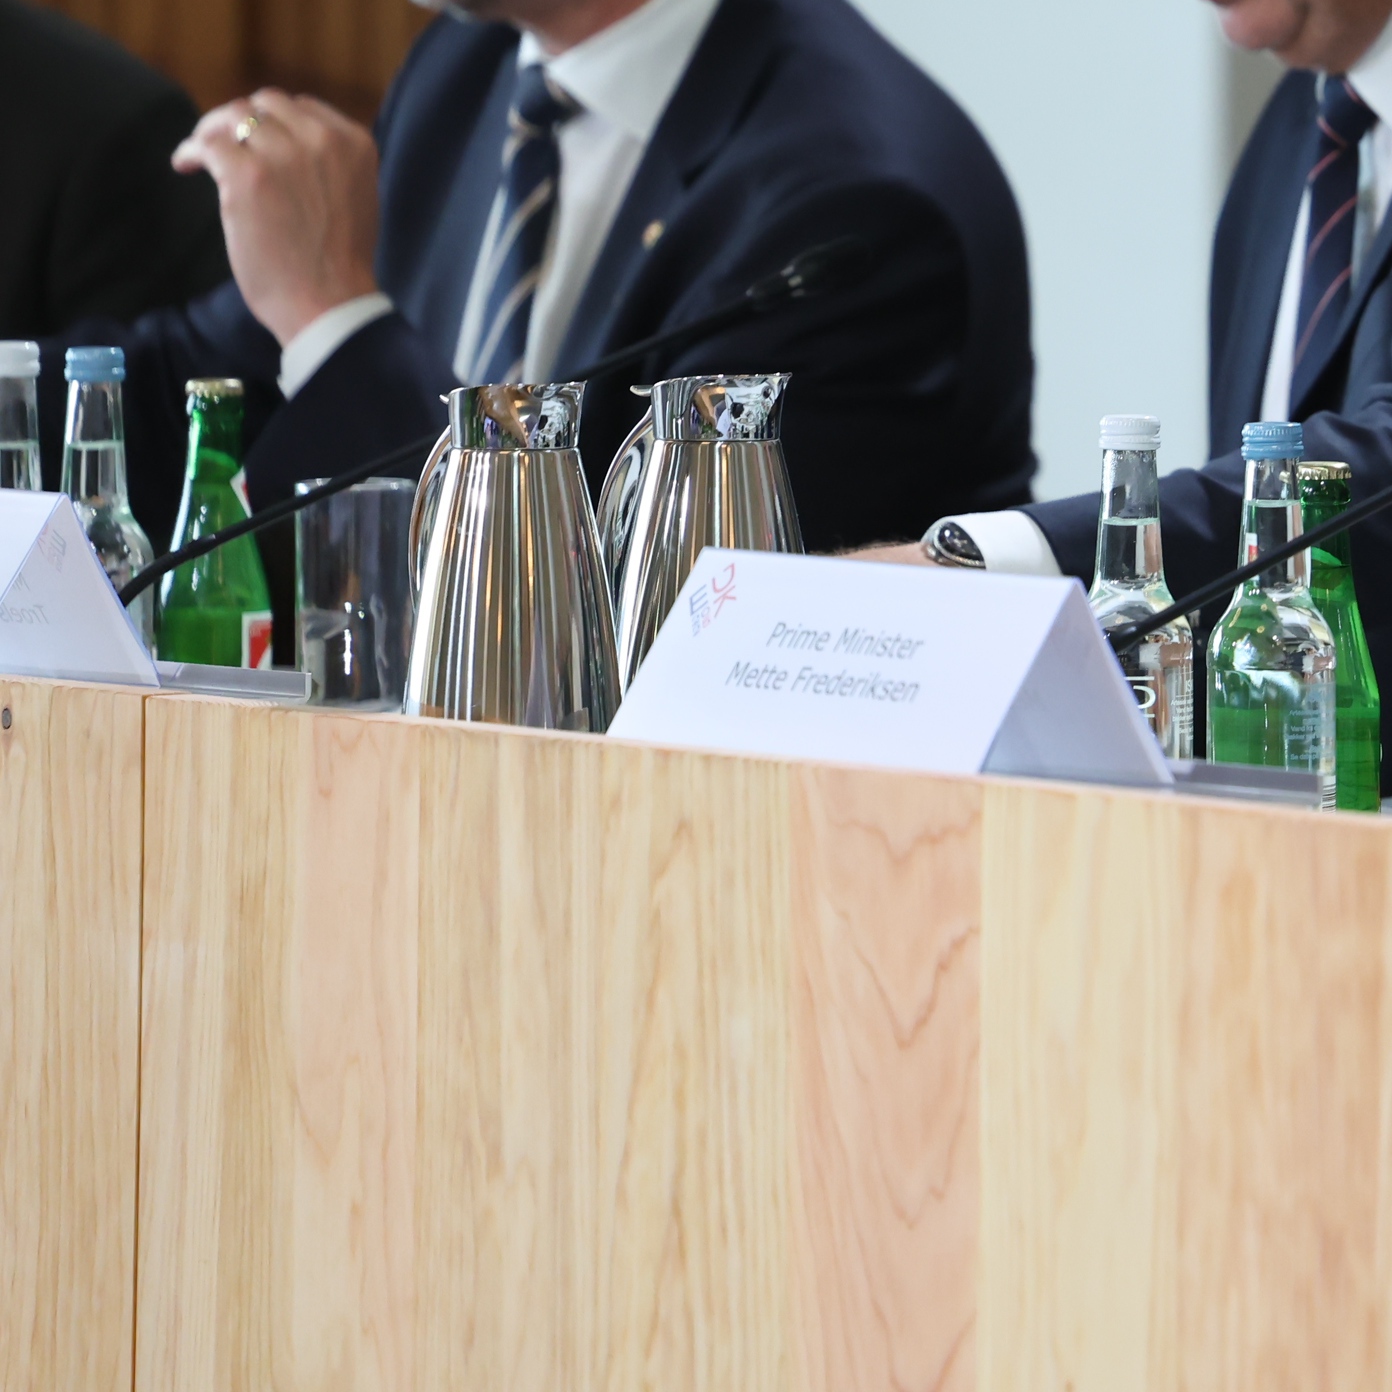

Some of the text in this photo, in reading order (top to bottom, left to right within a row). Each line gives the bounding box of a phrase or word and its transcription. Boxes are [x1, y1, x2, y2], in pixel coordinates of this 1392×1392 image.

[766, 621, 927, 660] Prime Minister
[725, 660, 920, 704] Mette Frederiksen
